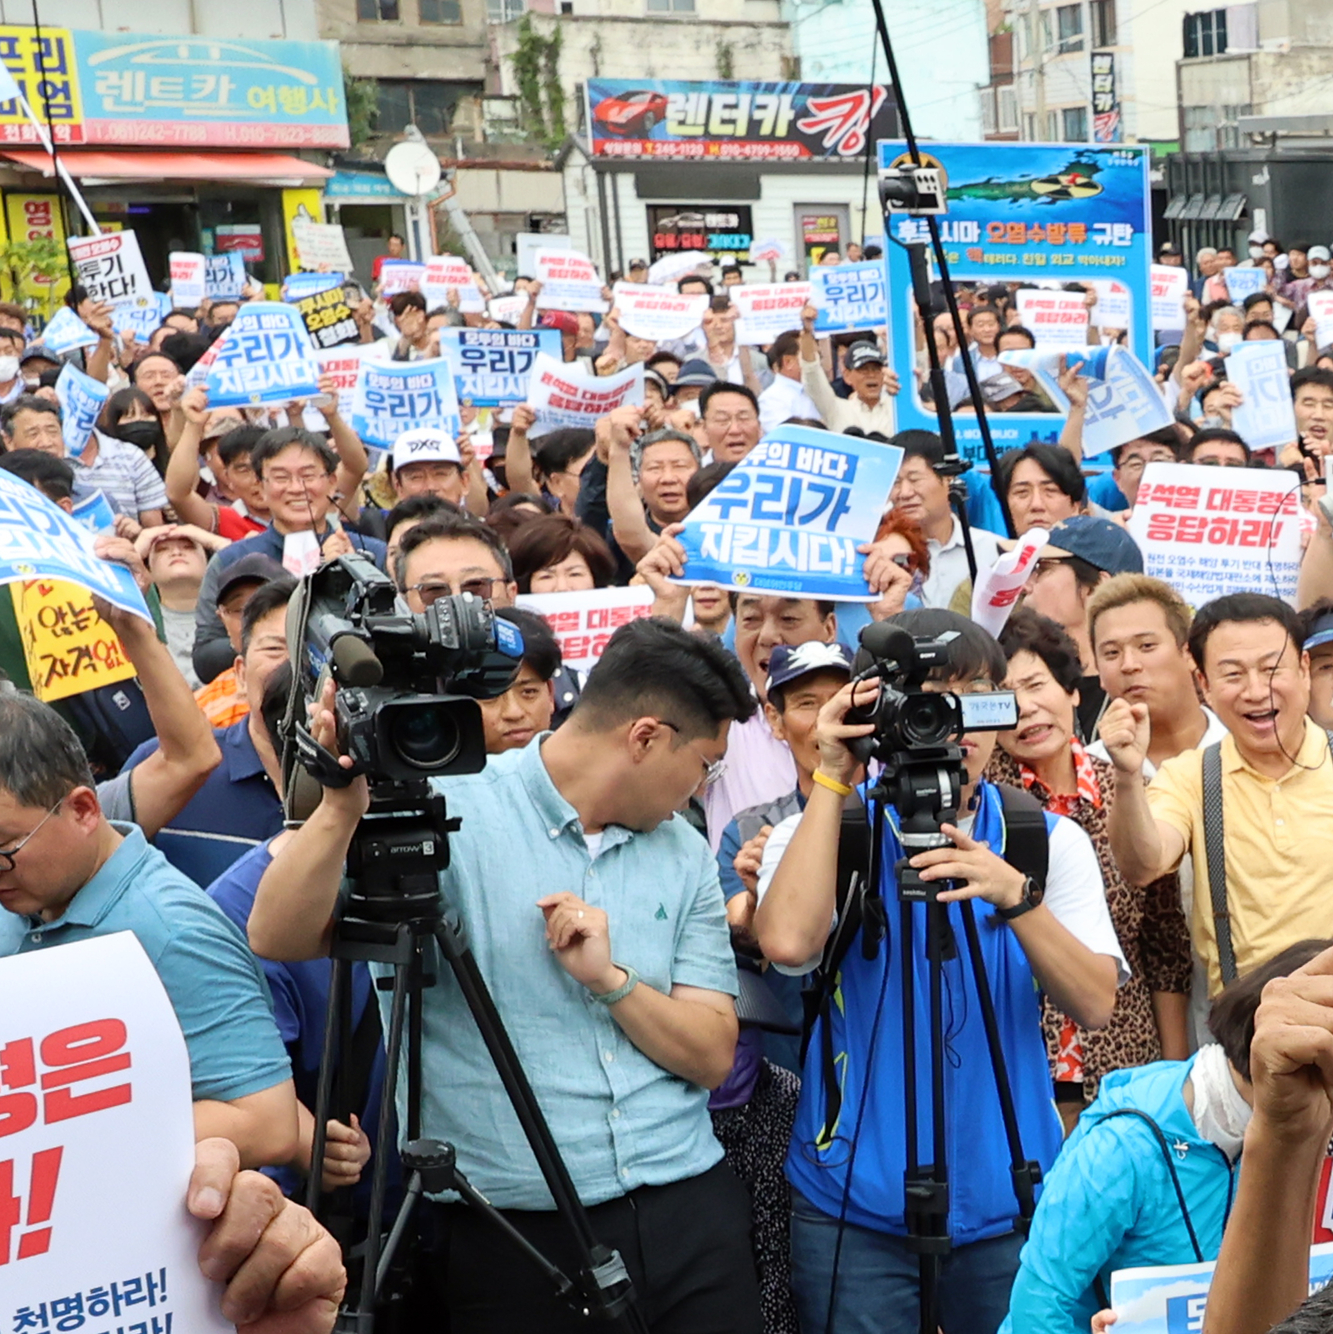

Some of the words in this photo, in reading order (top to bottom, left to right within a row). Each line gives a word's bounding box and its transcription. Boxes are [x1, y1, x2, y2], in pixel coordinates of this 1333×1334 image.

[247, 86, 338, 115] 여행사
[666, 93, 794, 138] 렌터카
[1093, 222, 1134, 246] 규탄
[260, 313, 291, 330] 바다
[306, 303, 351, 332] 오염수
[217, 332, 305, 367] 우리가
[465, 332, 505, 347] 모두의
[508, 332, 537, 347] 바다
[368, 372, 407, 390] 모두의
[408, 371, 433, 388] 바다
[365, 391, 443, 419] 우리가
[796, 442, 849, 479] 바다
[707, 472, 851, 532] 우리가
[1136, 483, 1202, 510] 윤석열
[1205, 487, 1299, 516] 대통령은
[1146, 513, 1284, 548] 응답하라!
[700, 522, 856, 576] 지킵시다!
[40, 643, 98, 688] 자격
[919, 651, 937, 660] SONY
[389, 845, 423, 854] arrow
[423, 841, 435, 856] 3
